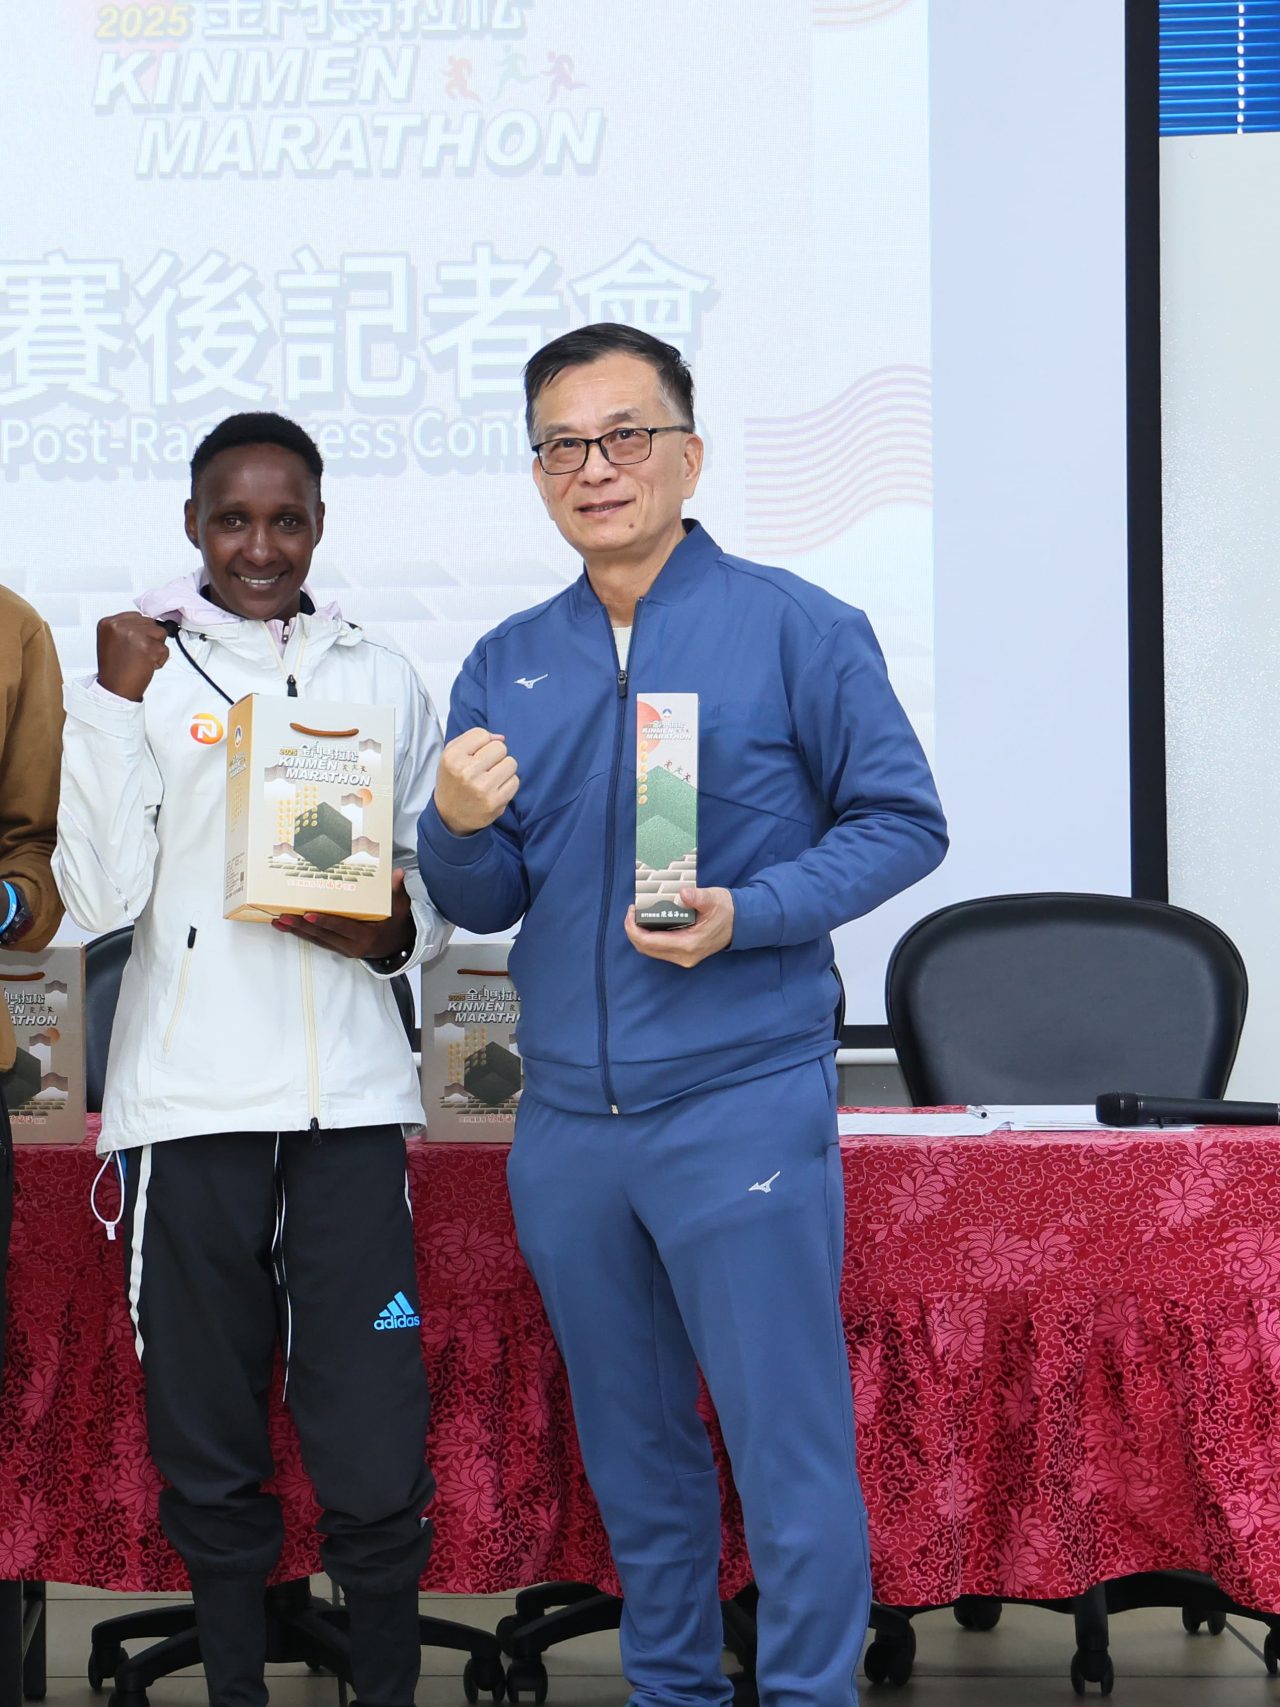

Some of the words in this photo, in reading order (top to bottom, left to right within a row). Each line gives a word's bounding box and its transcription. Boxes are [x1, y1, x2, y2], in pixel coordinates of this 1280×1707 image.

[96, 7, 190, 38] 2025
[95, 45, 418, 110] KINMEN
[135, 108, 605, 177] MARATHON
[0, 417, 213, 465] Post-Ra
[308, 422, 398, 460] ess
[278, 756, 338, 771] KINMEN
[286, 768, 371, 787] MARATHON
[447, 1002, 505, 1012] KINMEN
[11, 1015, 58, 1026] ATHON
[454, 1013, 521, 1023] MARATH
[373, 1314, 420, 1330] adidas
